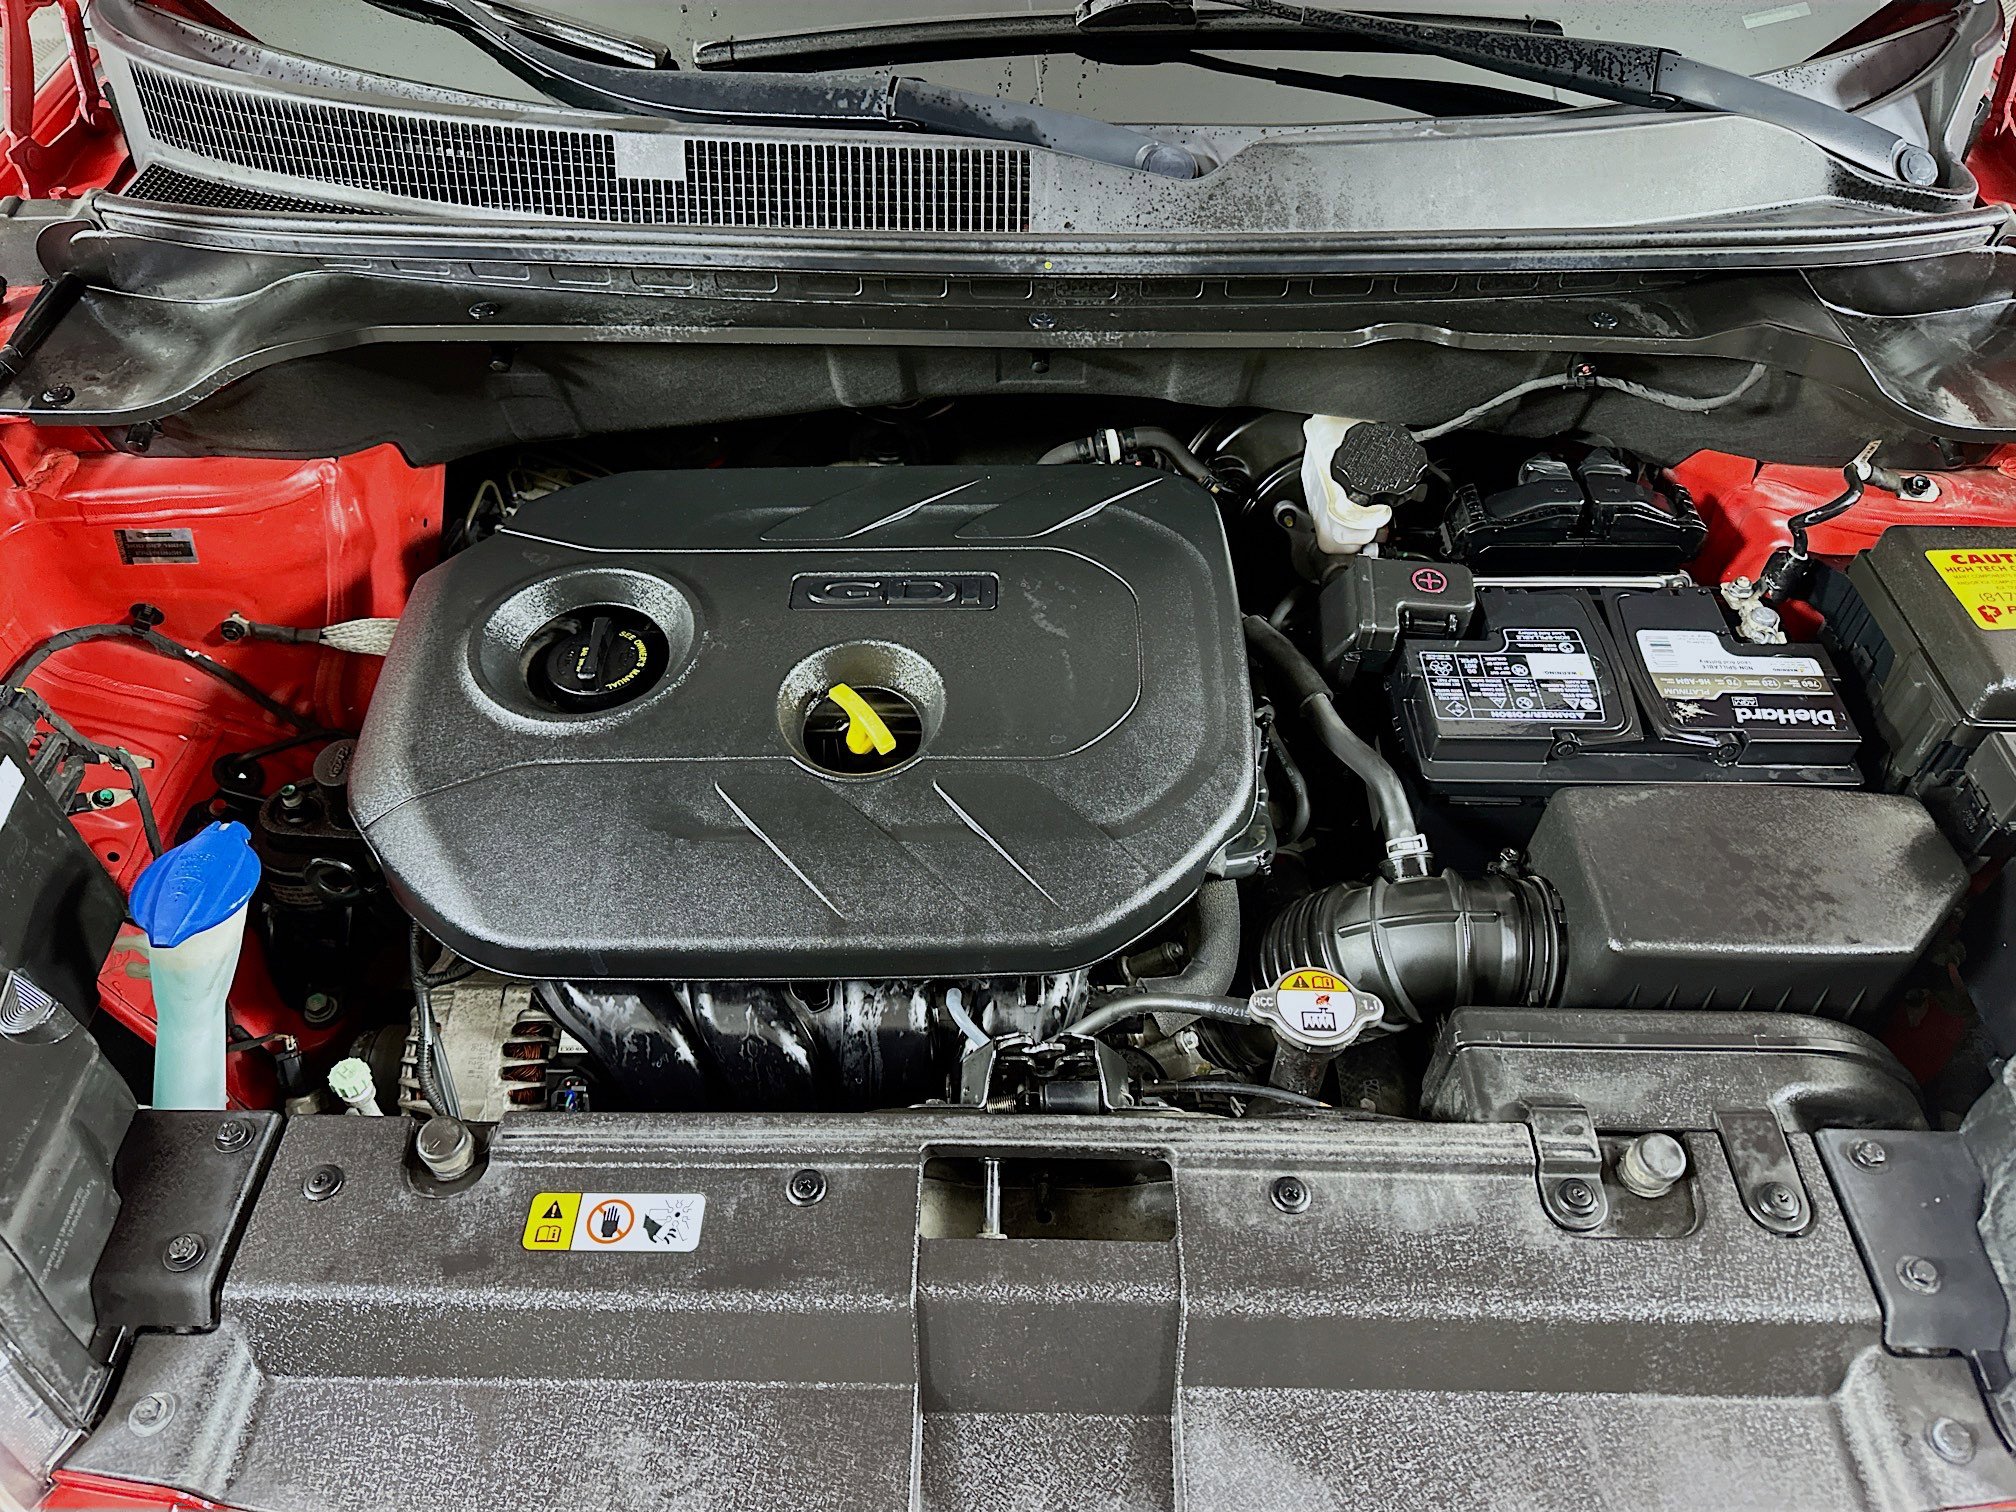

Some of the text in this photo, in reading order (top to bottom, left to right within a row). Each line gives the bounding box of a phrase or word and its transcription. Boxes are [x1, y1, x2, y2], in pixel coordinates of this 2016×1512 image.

[807, 578, 981, 604] GDI
[1979, 592, 2016, 602] (817
[605, 630, 648, 690] SEE OWNER'S MANUAL
[1761, 679, 1779, 688] 120
[1664, 687, 1710, 695] PLATINUM
[1734, 706, 1836, 725] DieHard
[1253, 996, 1378, 1010] HCC 1.1
